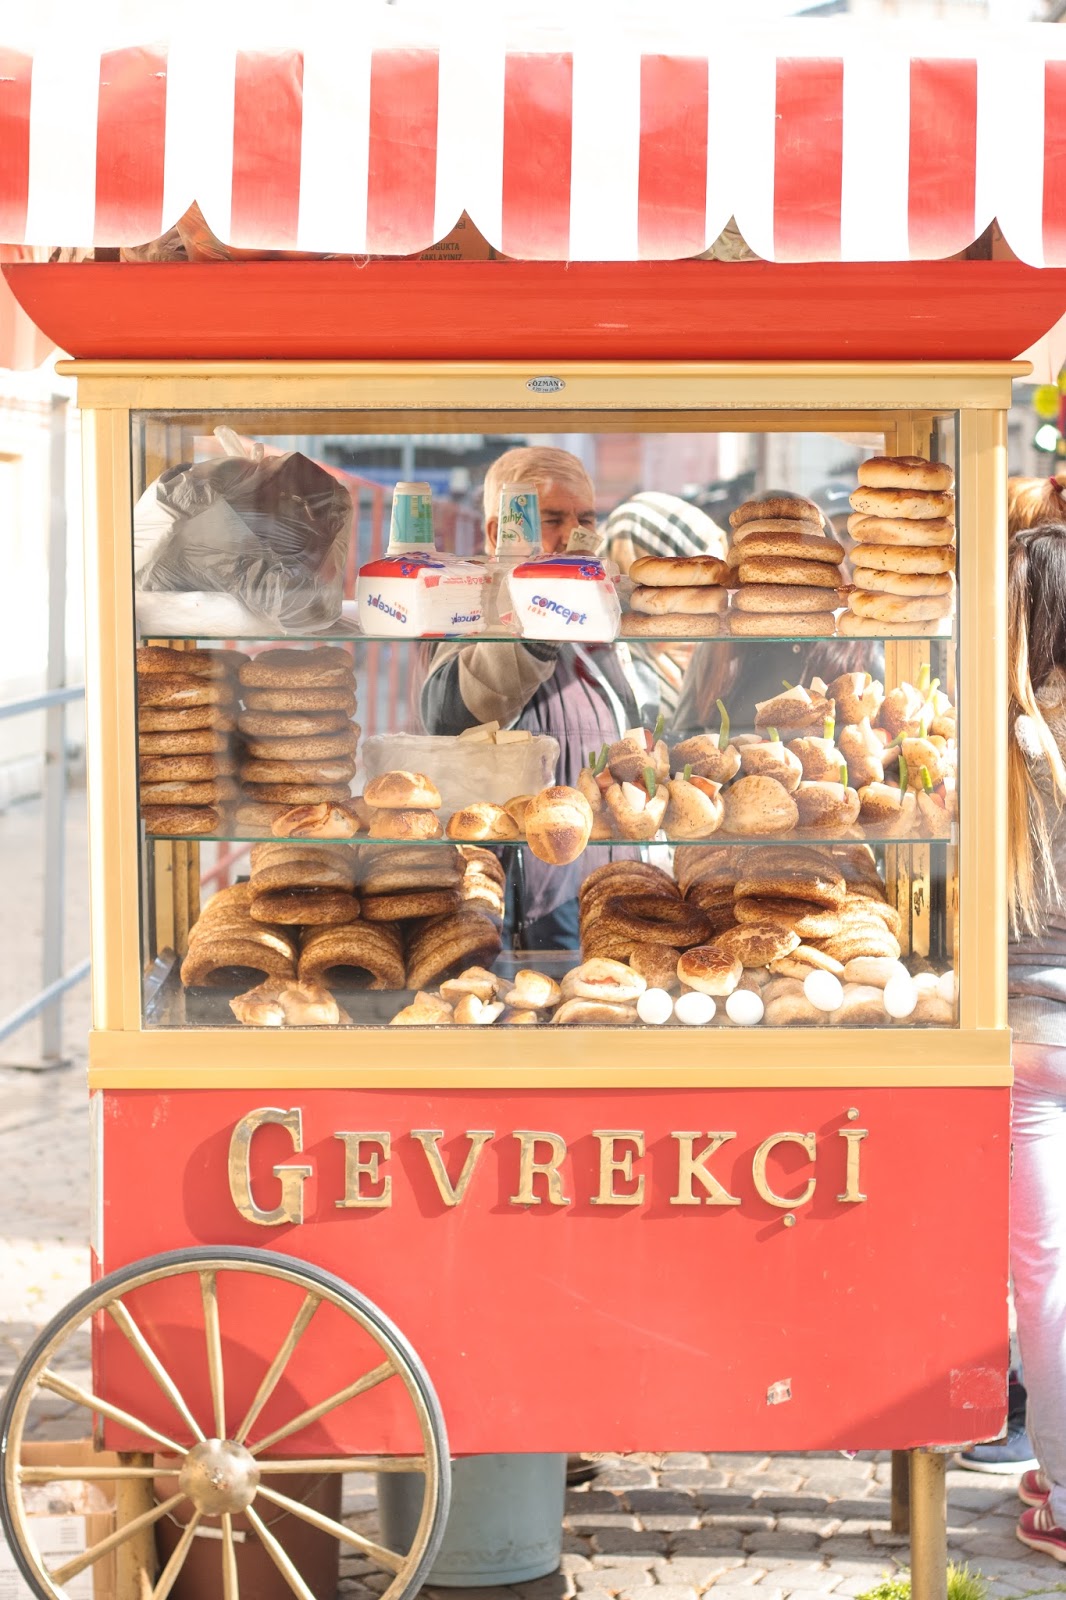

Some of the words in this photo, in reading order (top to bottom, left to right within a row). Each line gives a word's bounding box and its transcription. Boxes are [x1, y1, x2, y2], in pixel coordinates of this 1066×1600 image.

[367, 594, 407, 624] concept
[532, 595, 587, 625] concept
[228, 1106, 869, 1227] GEVREKÇİ
